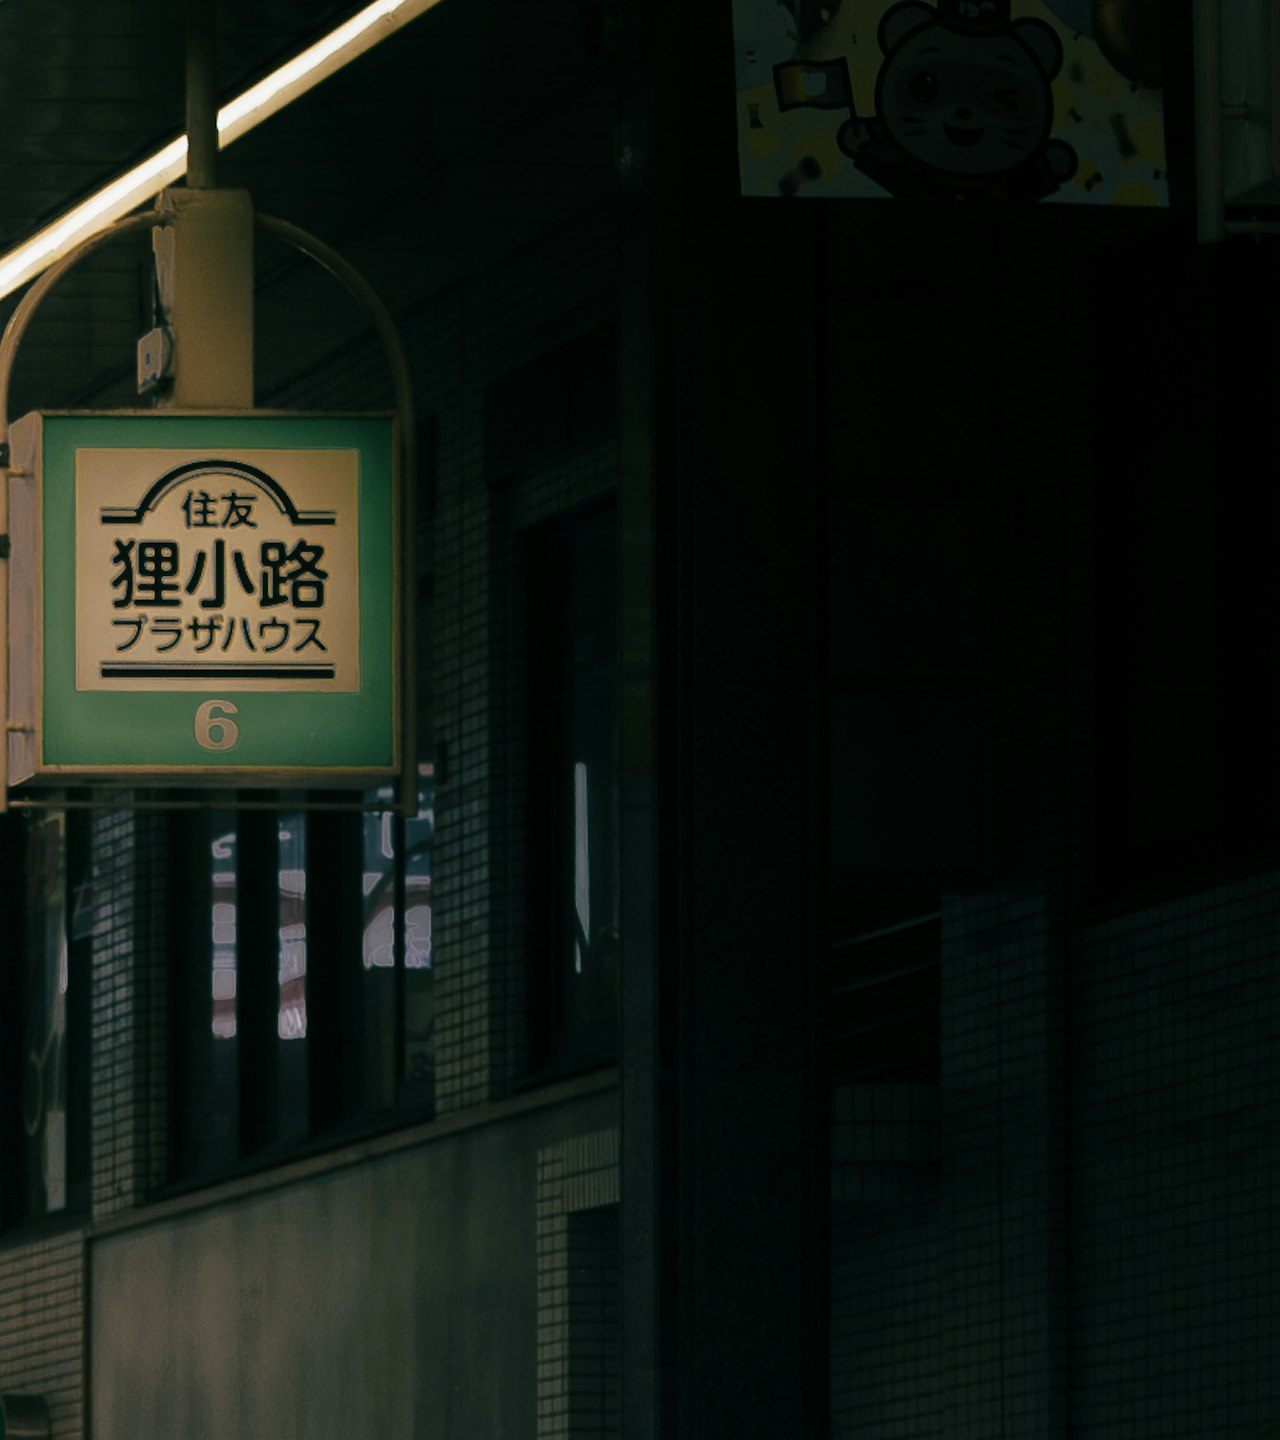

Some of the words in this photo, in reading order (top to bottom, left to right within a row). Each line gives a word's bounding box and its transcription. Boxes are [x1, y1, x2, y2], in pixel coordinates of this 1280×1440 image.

[181, 491, 258, 530] 住友
[112, 539, 329, 610] 狸小路
[114, 616, 328, 653] プラザハウス
[193, 699, 240, 752] 6
